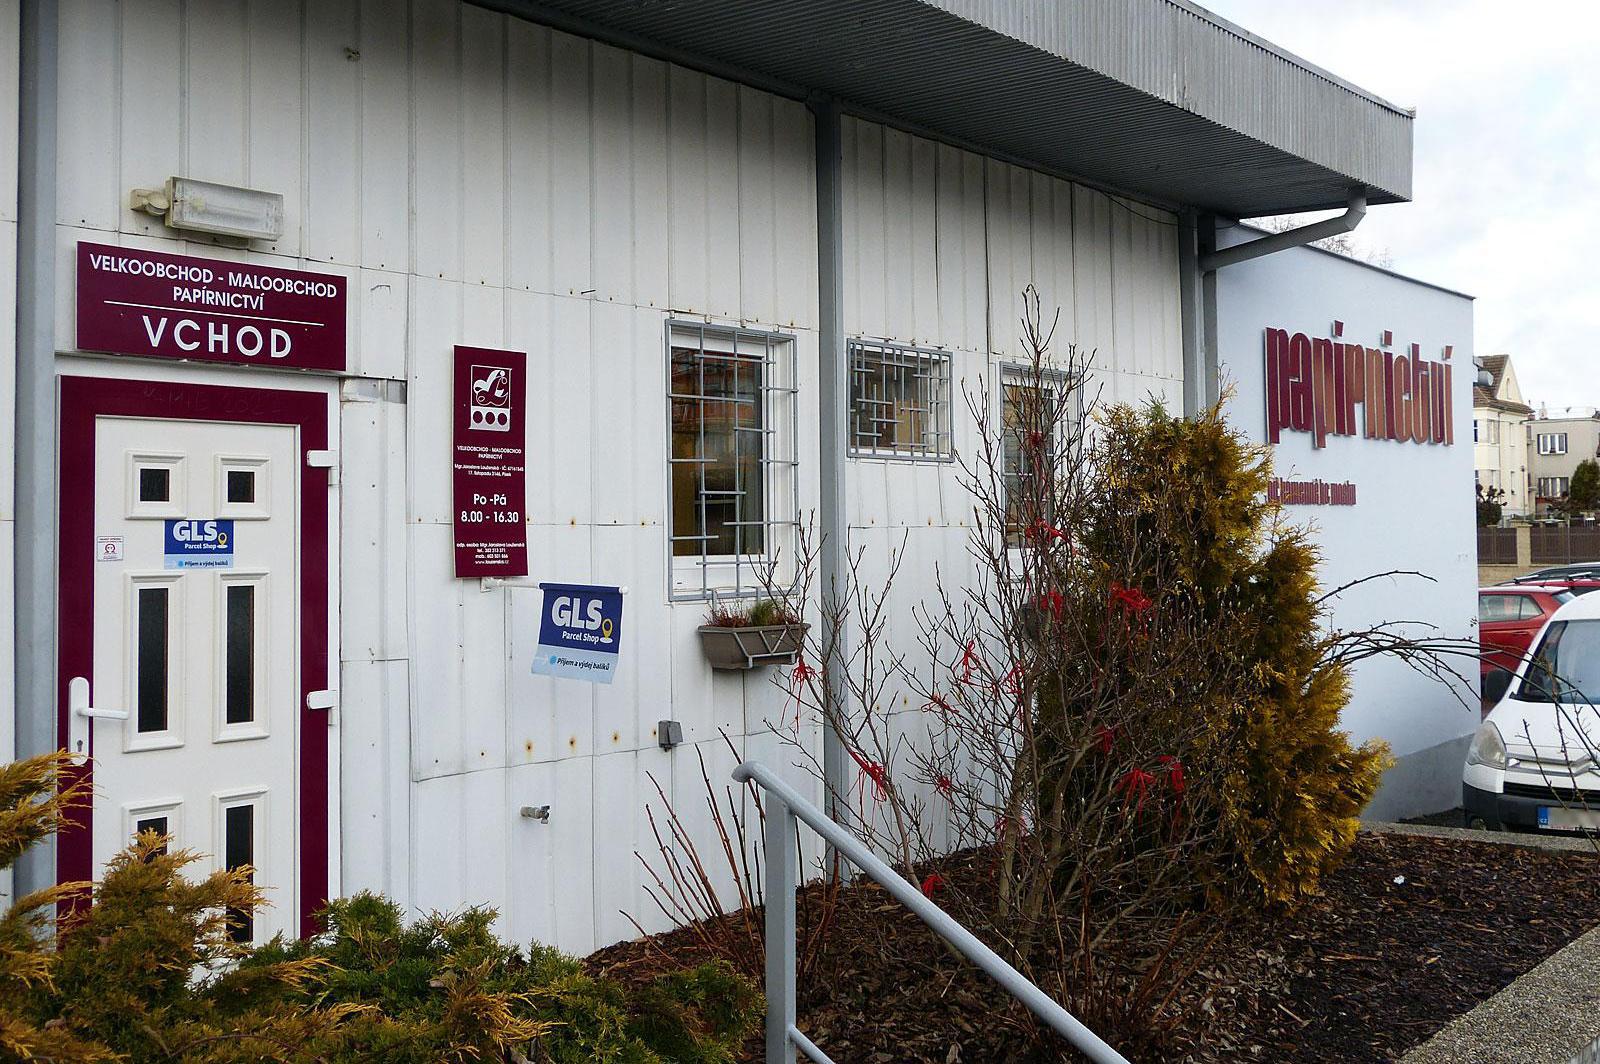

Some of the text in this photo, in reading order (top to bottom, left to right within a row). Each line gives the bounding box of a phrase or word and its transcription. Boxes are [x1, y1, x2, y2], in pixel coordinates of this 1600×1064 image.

[89, 253, 213, 283] VELKOOBCHOD
[228, 273, 337, 298] MALOOBCHOD
[173, 285, 264, 311] PAPÍRNICTVÍ
[142, 315, 292, 358] VCHOD
[473, 493, 487, 505] Po
[461, 510, 483, 523] 8.00
[493, 511, 519, 523] 16.30
[173, 521, 218, 542] GLS
[203, 543, 217, 551] Shop
[551, 596, 603, 631] GLS
[562, 631, 600, 645] Parcel Shop
